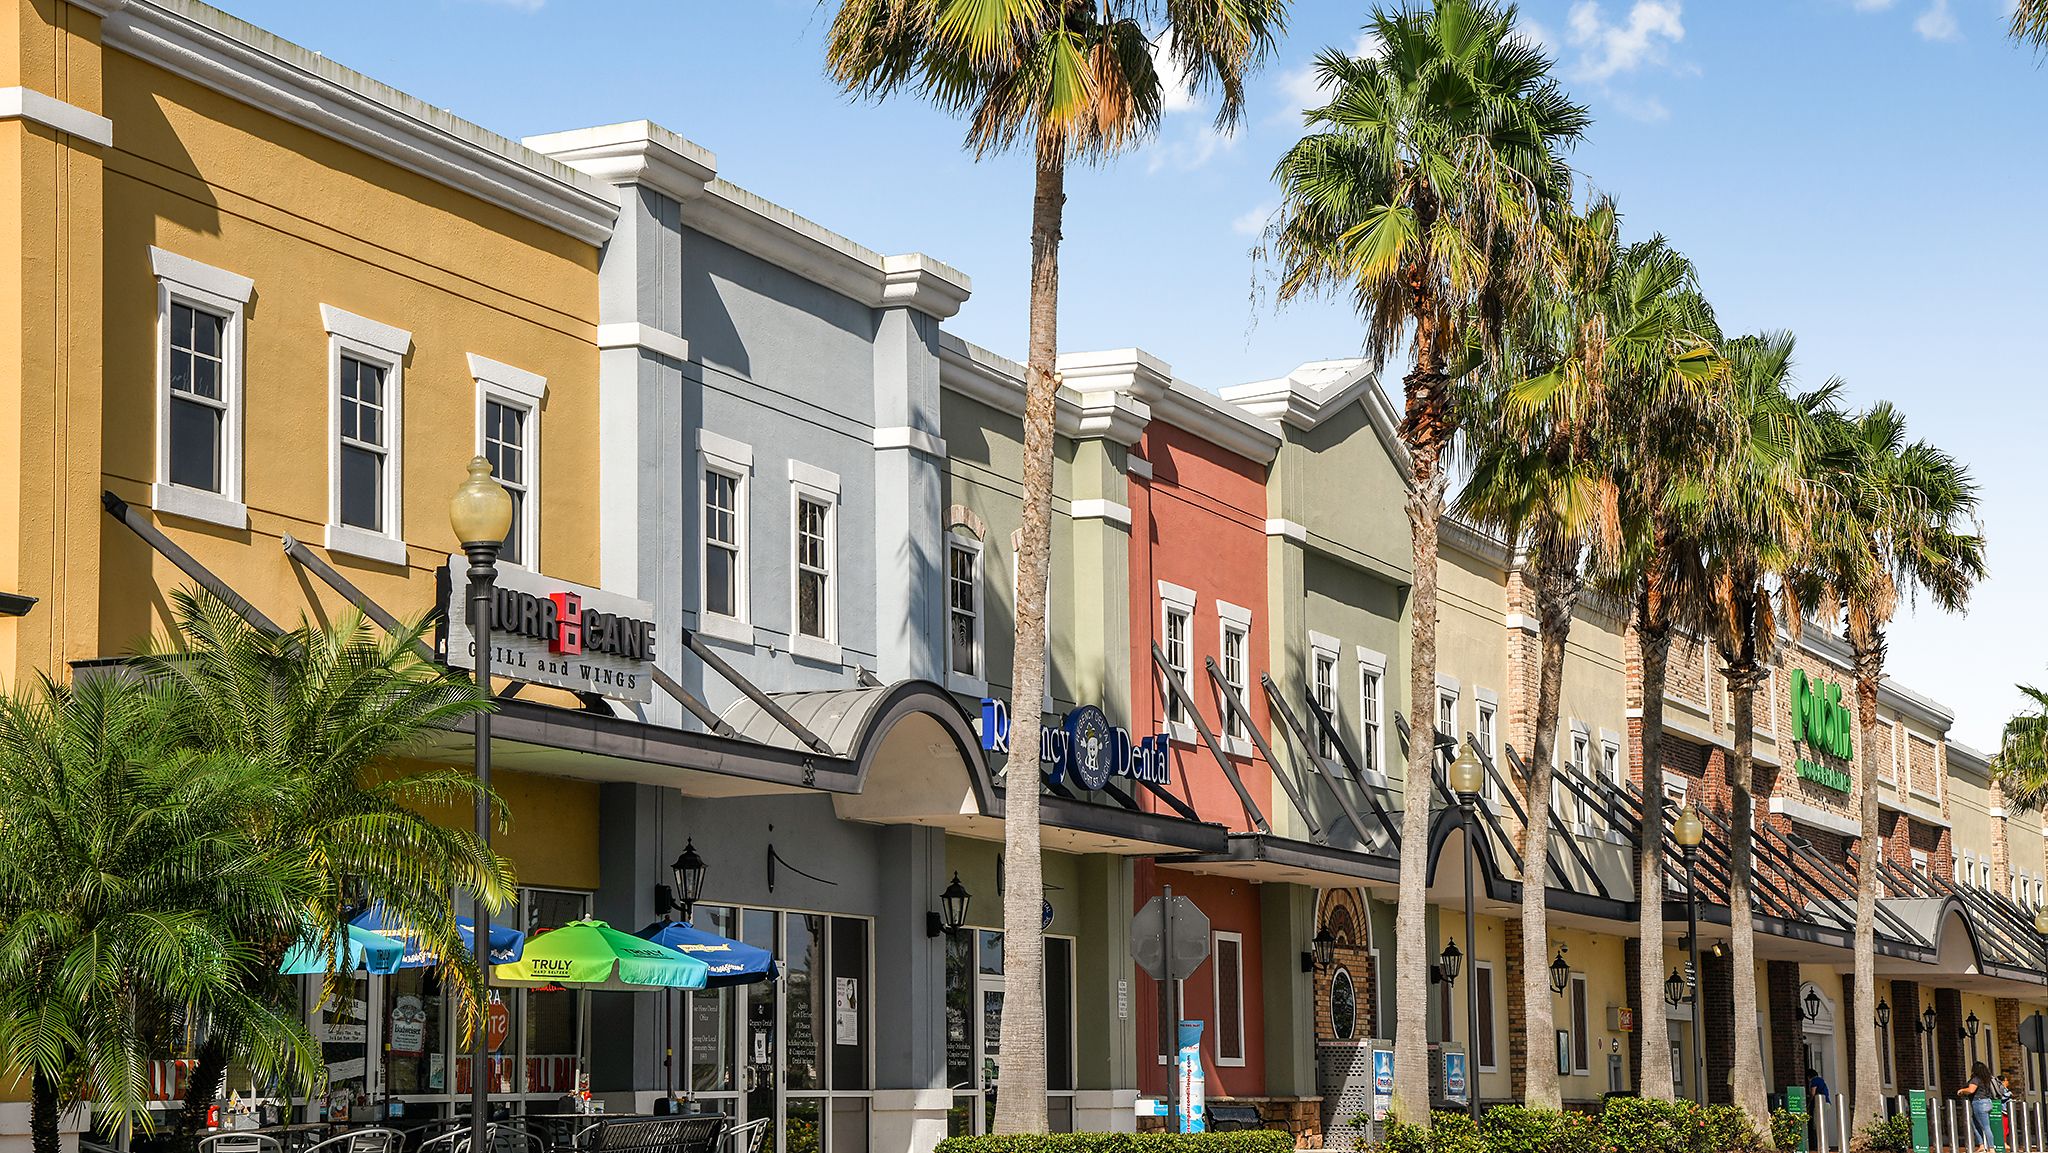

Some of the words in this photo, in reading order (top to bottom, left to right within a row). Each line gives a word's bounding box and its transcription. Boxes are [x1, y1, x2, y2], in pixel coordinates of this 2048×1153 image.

[468, 641, 527, 668] GILL
[538, 659, 569, 676] and
[580, 665, 637, 690] WINGS
[982, 698, 1070, 783] Rncy
[1114, 727, 1171, 785] Dental
[532, 959, 573, 970] TRULY
